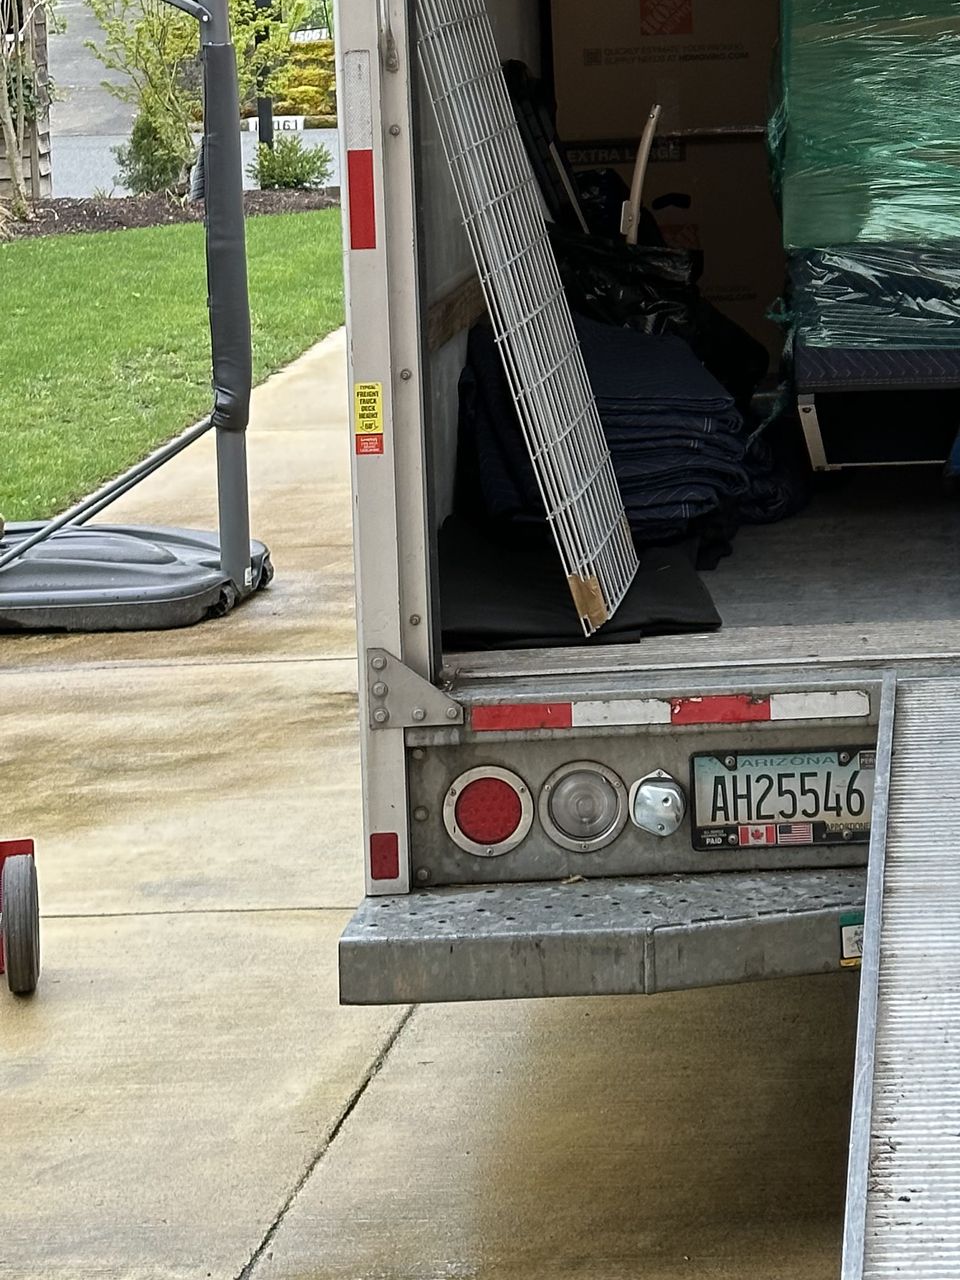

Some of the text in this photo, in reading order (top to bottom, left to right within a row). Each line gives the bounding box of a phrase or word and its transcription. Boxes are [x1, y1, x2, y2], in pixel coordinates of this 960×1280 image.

[566, 146, 681, 161] EXTRA LGE
[740, 755, 836, 768] ARIZONA
[711, 771, 865, 822] AH25546
[706, 837, 722, 845] PAID
